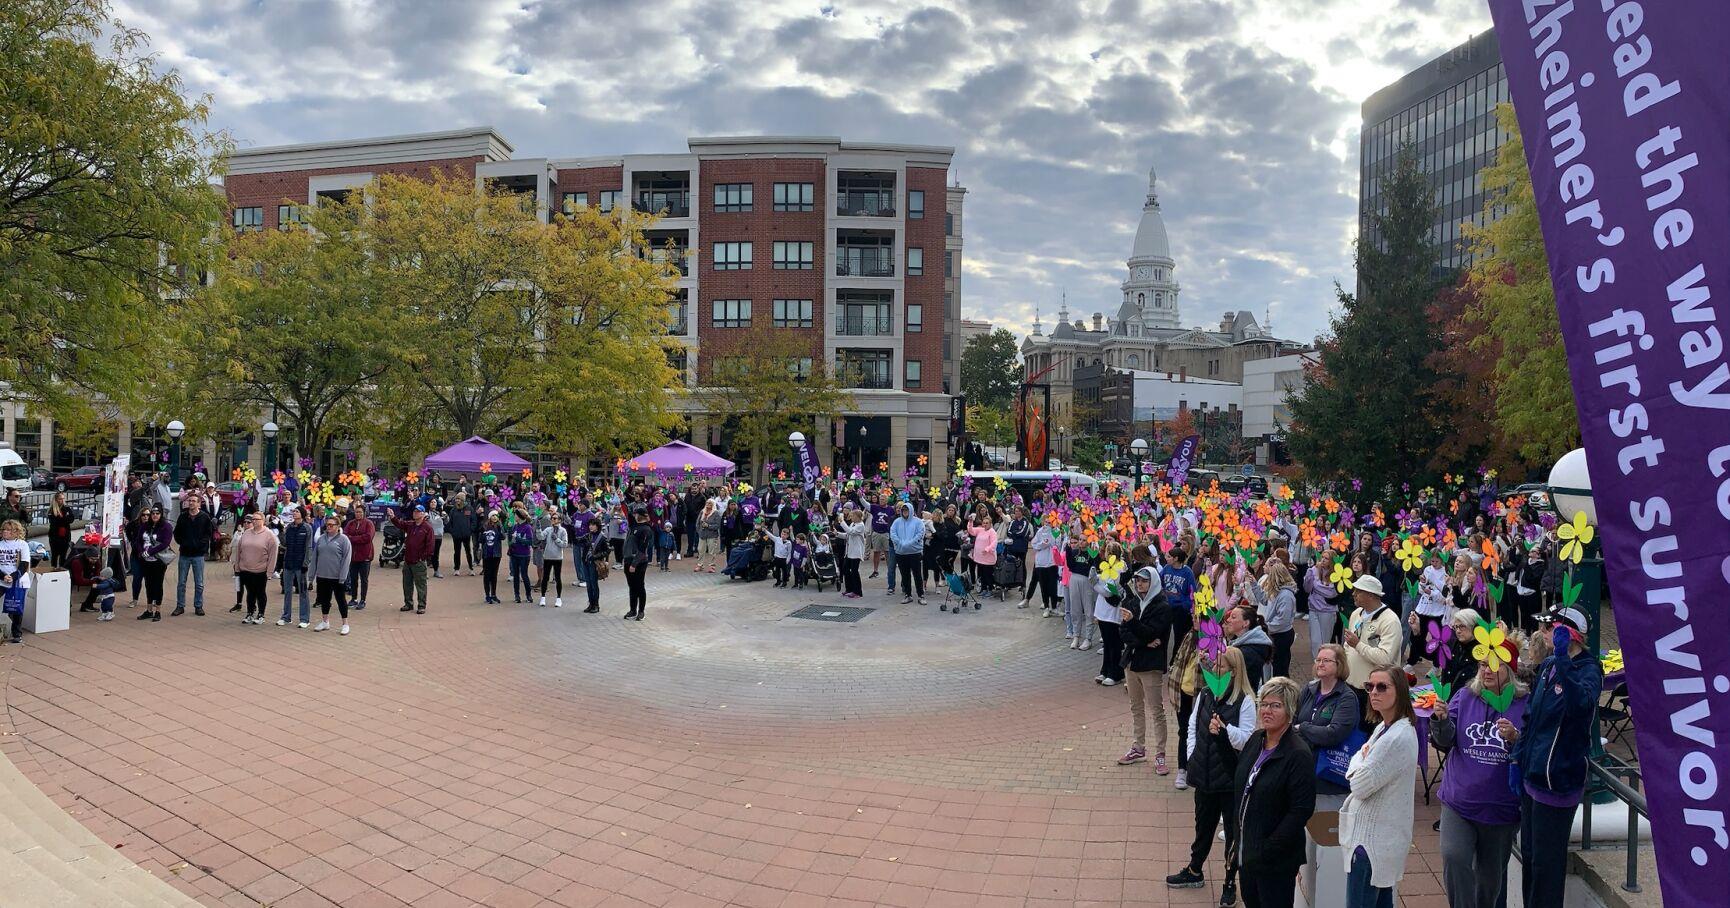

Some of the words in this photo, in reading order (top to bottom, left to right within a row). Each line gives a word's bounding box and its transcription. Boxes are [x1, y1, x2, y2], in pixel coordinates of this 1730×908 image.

[1601, 0, 1681, 117] ead
[1635, 125, 1698, 249] the
[1666, 263, 1730, 409] way
[1179, 440, 1192, 462] YOU
[1589, 309, 1664, 475] first
[1630, 497, 1729, 865] survivor.
[1463, 747, 1487, 757] WESLEY
